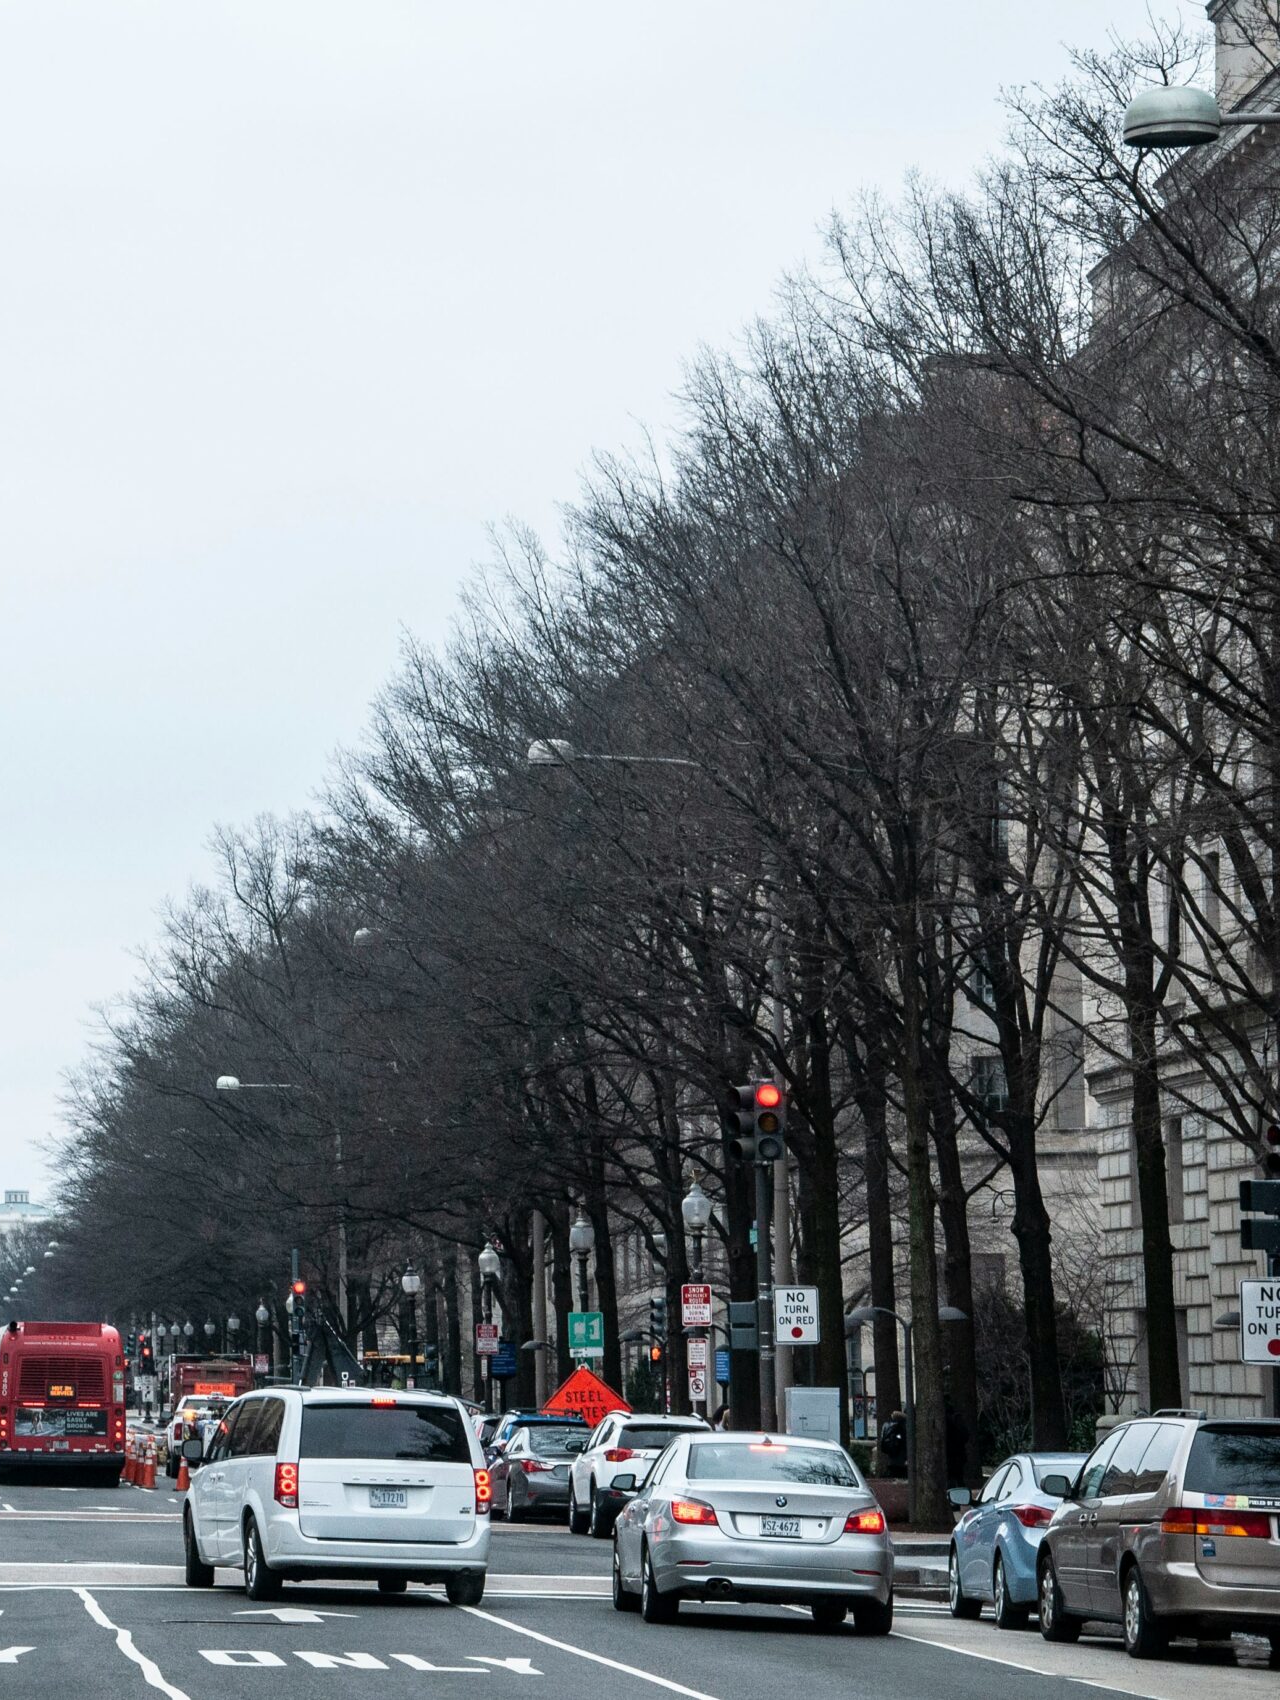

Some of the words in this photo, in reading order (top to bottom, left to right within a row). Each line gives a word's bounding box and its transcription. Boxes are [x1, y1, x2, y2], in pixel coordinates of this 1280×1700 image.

[786, 1292, 805, 1302] NO
[784, 1305, 809, 1313] TURN
[778, 1316, 792, 1325] ON
[796, 1316, 815, 1325] RED
[1247, 1322, 1268, 1335] ON
[565, 1390, 603, 1403] STEEL
[197, 1649, 545, 1675] ONLY
